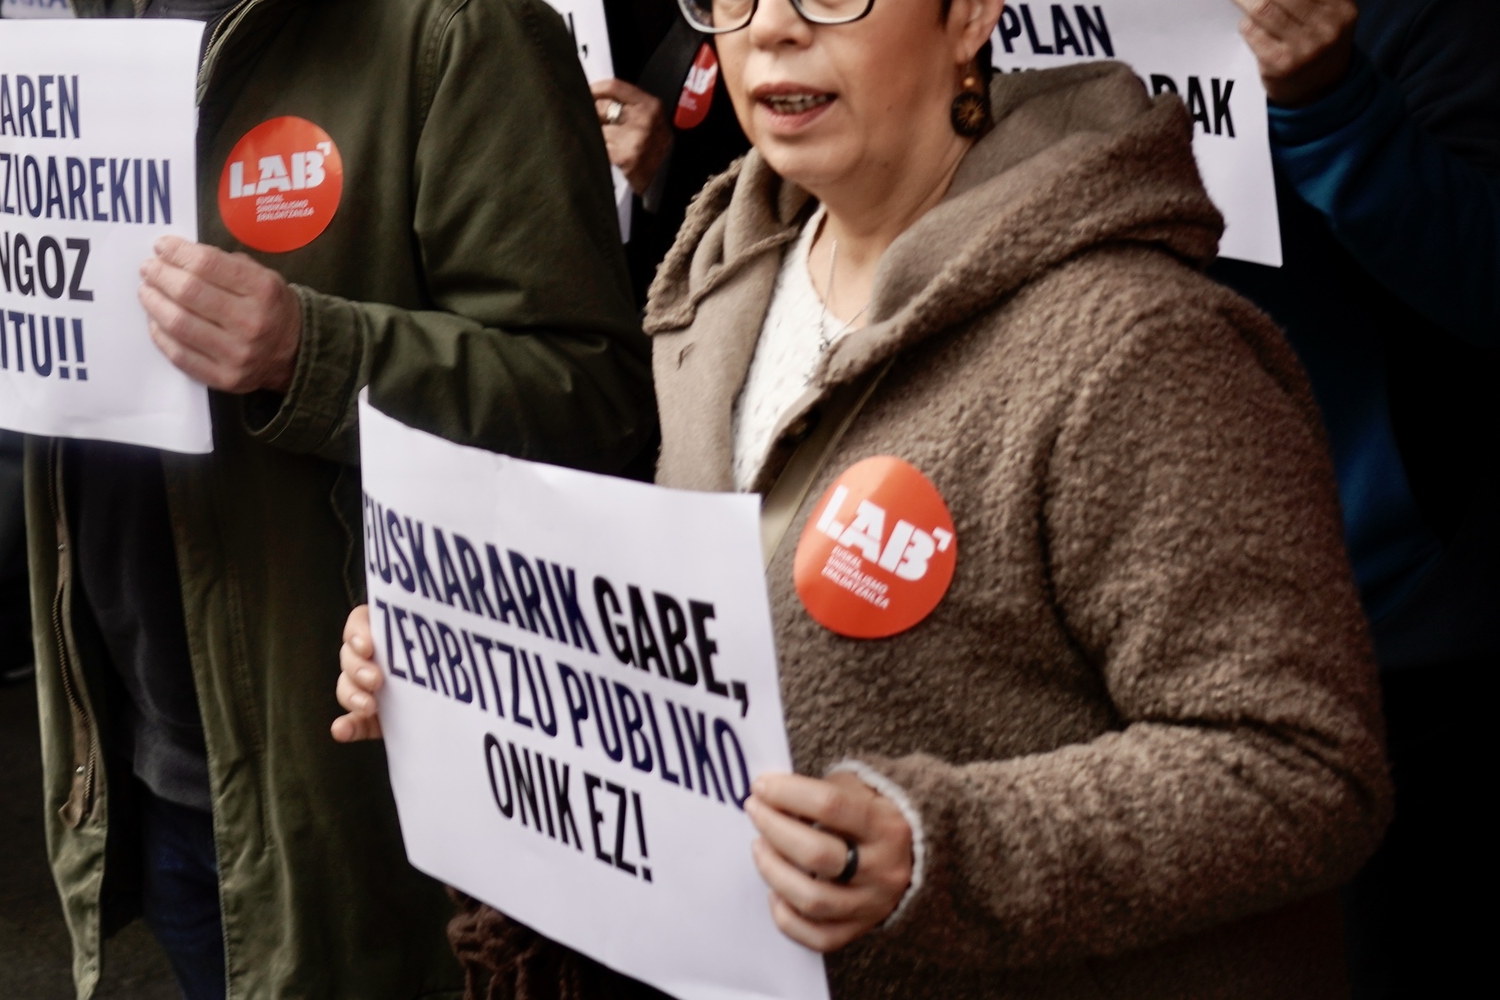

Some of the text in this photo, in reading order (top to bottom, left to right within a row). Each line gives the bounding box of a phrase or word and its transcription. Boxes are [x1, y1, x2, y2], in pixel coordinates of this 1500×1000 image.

[999, 4, 1115, 57] PLAN
[229, 149, 327, 199] LAB
[816, 484, 937, 582] LAB
[362, 492, 749, 718] EUSKARARIK GABE,
[375, 597, 752, 812] ZERBITZU PUBLIKO
[484, 733, 653, 883] ONIK EZ!
